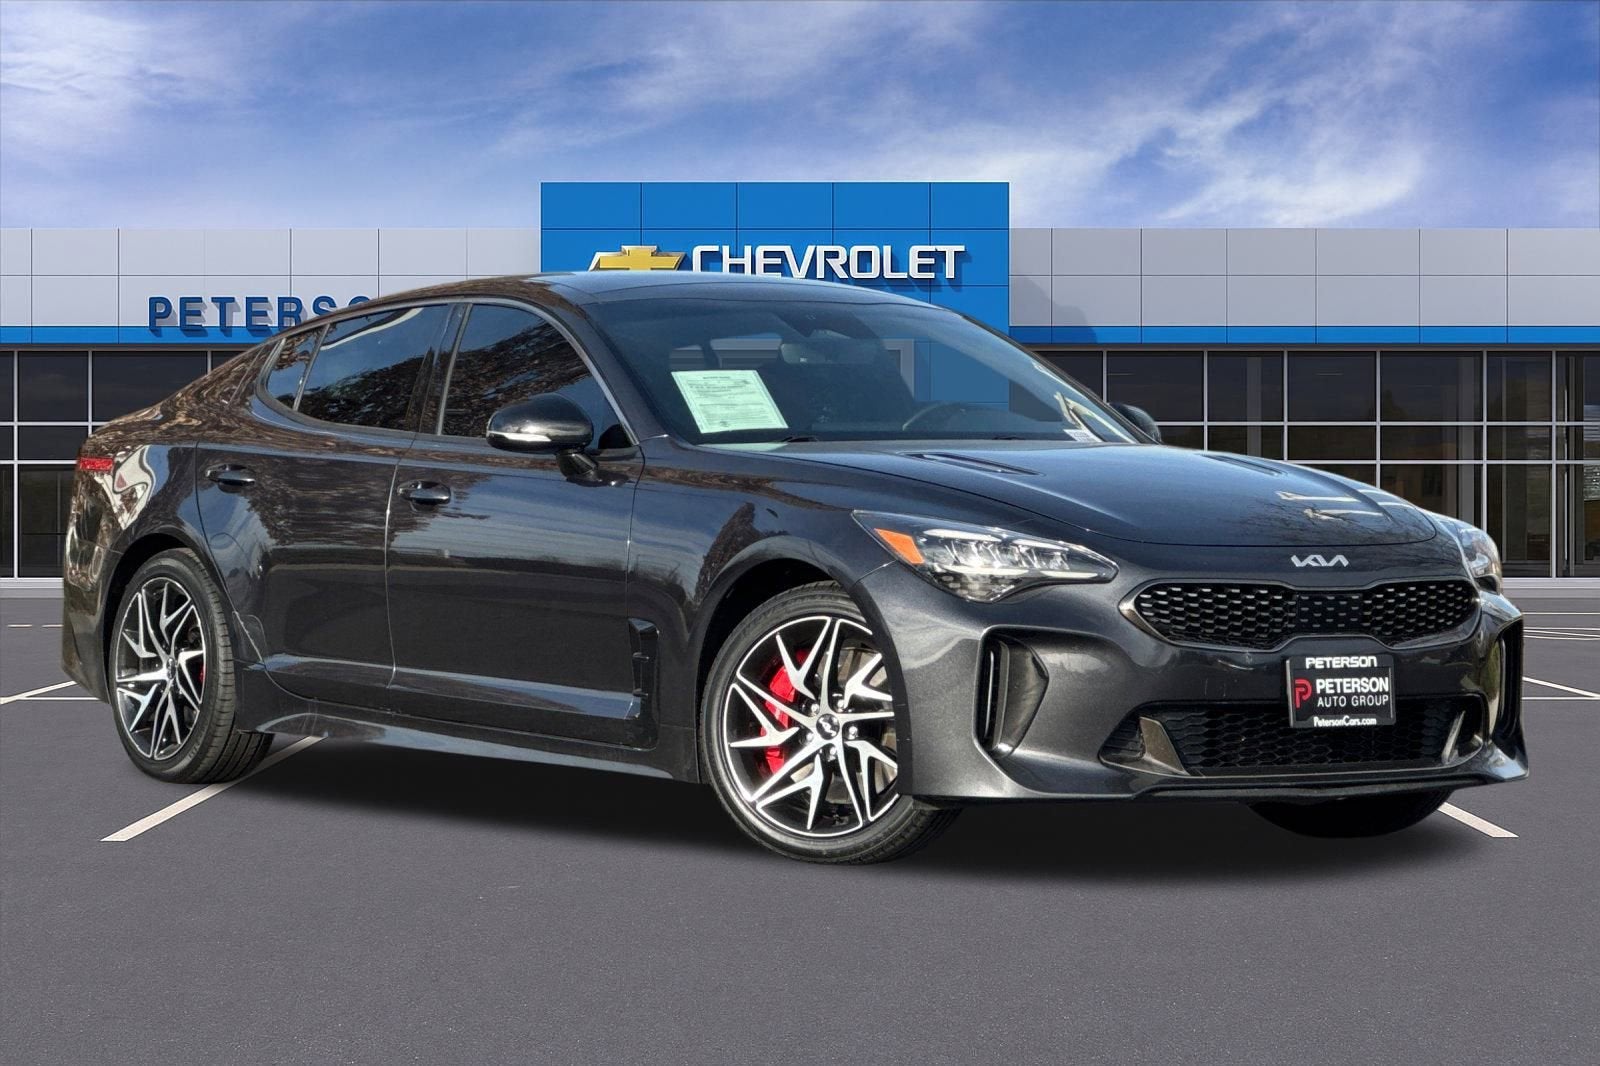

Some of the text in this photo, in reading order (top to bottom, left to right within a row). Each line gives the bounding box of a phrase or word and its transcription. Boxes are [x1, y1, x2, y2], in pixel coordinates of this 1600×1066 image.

[692, 244, 965, 279] CHEVROLET
[148, 296, 371, 331] PETERS
[1305, 656, 1377, 669] PETERSON
[1315, 677, 1389, 694] PETERSON
[1317, 694, 1389, 707] AUTO GROUP
[1313, 715, 1377, 727] PetersonCars.com
